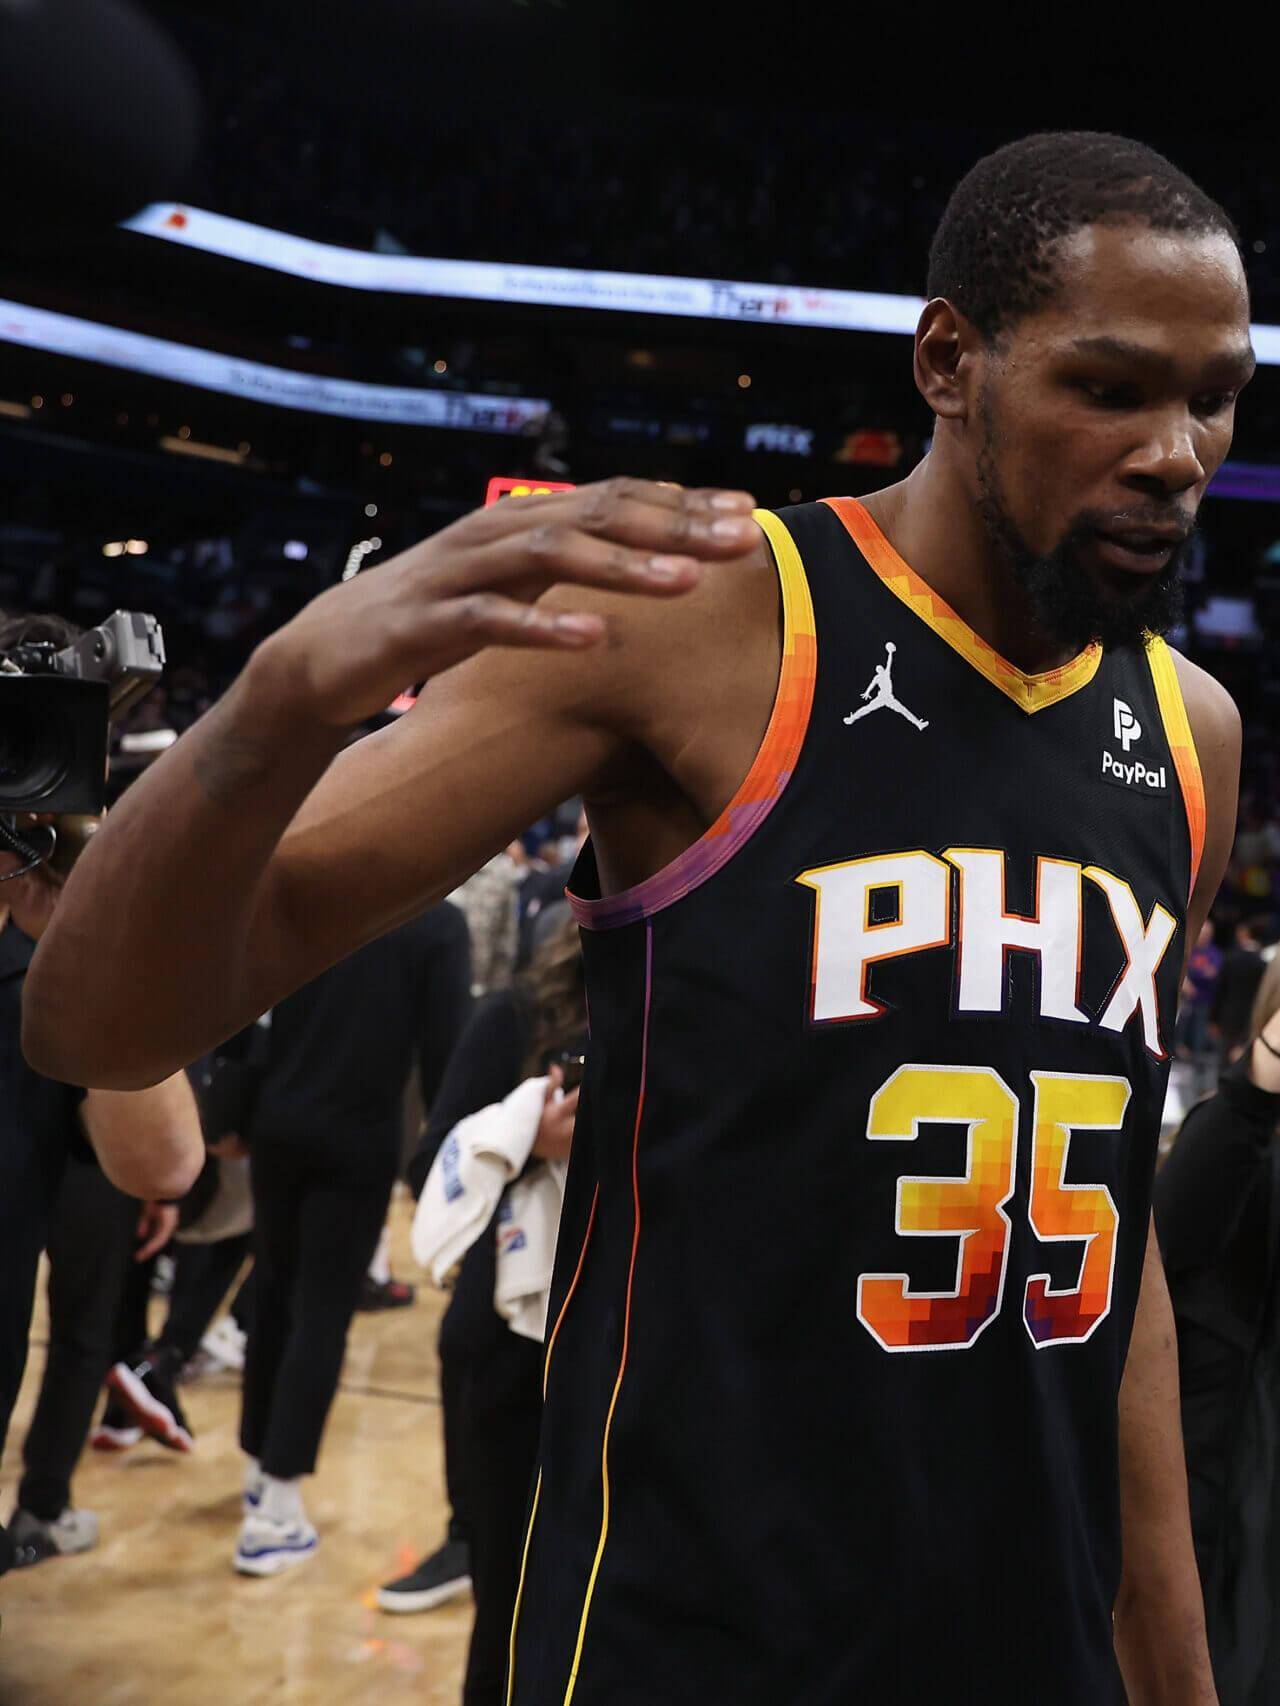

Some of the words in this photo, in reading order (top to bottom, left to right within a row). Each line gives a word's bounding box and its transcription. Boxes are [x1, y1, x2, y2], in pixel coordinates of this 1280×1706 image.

[1102, 751, 1166, 788] PayPal
[795, 847, 1178, 1060] PHX
[856, 1064, 1132, 1353] 35
